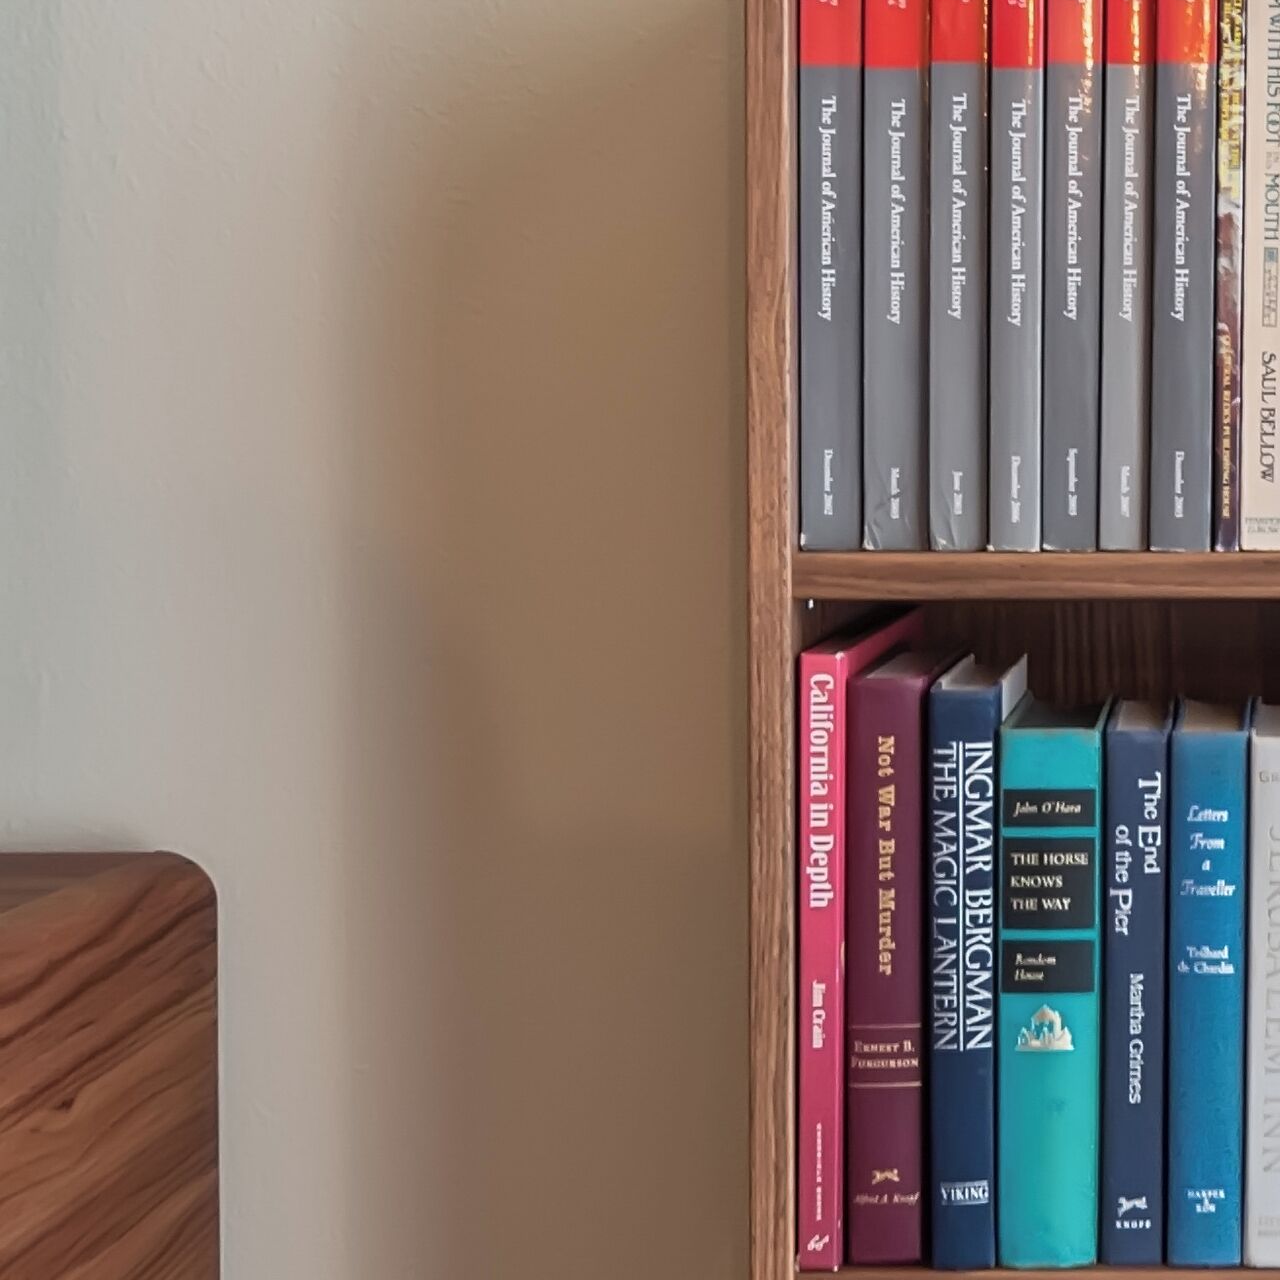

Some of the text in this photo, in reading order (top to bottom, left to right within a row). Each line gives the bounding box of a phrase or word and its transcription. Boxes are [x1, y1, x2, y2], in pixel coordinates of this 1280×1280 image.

[817, 96, 838, 321] The Journal of American History
[886, 99, 906, 324] The Journal of American History
[947, 93, 968, 320] The Journal of American History
[1007, 99, 1028, 327] The Journal of American History
[1063, 96, 1084, 321] The Journal of American History
[1118, 95, 1140, 322] The Journal of American History
[1171, 94, 1192, 322] The Journal of American History
[1262, 172, 1280, 241] MOUTH
[1259, 351, 1278, 484] SAUL BELLOW
[805, 673, 835, 909] California in Depth
[1012, 801, 1039, 818] John
[1137, 771, 1163, 874] The End
[1186, 805, 1229, 823] Letters
[1189, 832, 1225, 851] From
[877, 735, 897, 976] Not War But Murder
[932, 741, 958, 1051] THE MAGIC LANTERN
[964, 741, 994, 1051] INGMAR BERGMAN
[1010, 852, 1089, 866] THE HORSE
[1010, 875, 1064, 889] KNOWS
[1010, 896, 1072, 911] THE WAY
[1109, 824, 1133, 937] of the Pier
[1180, 878, 1236, 897] Traveller
[1201, 858, 1211, 871] a
[811, 980, 827, 1049] Jim Crain
[1128, 972, 1145, 1105] Martha Grimes
[940, 1184, 990, 1202] VIKING
